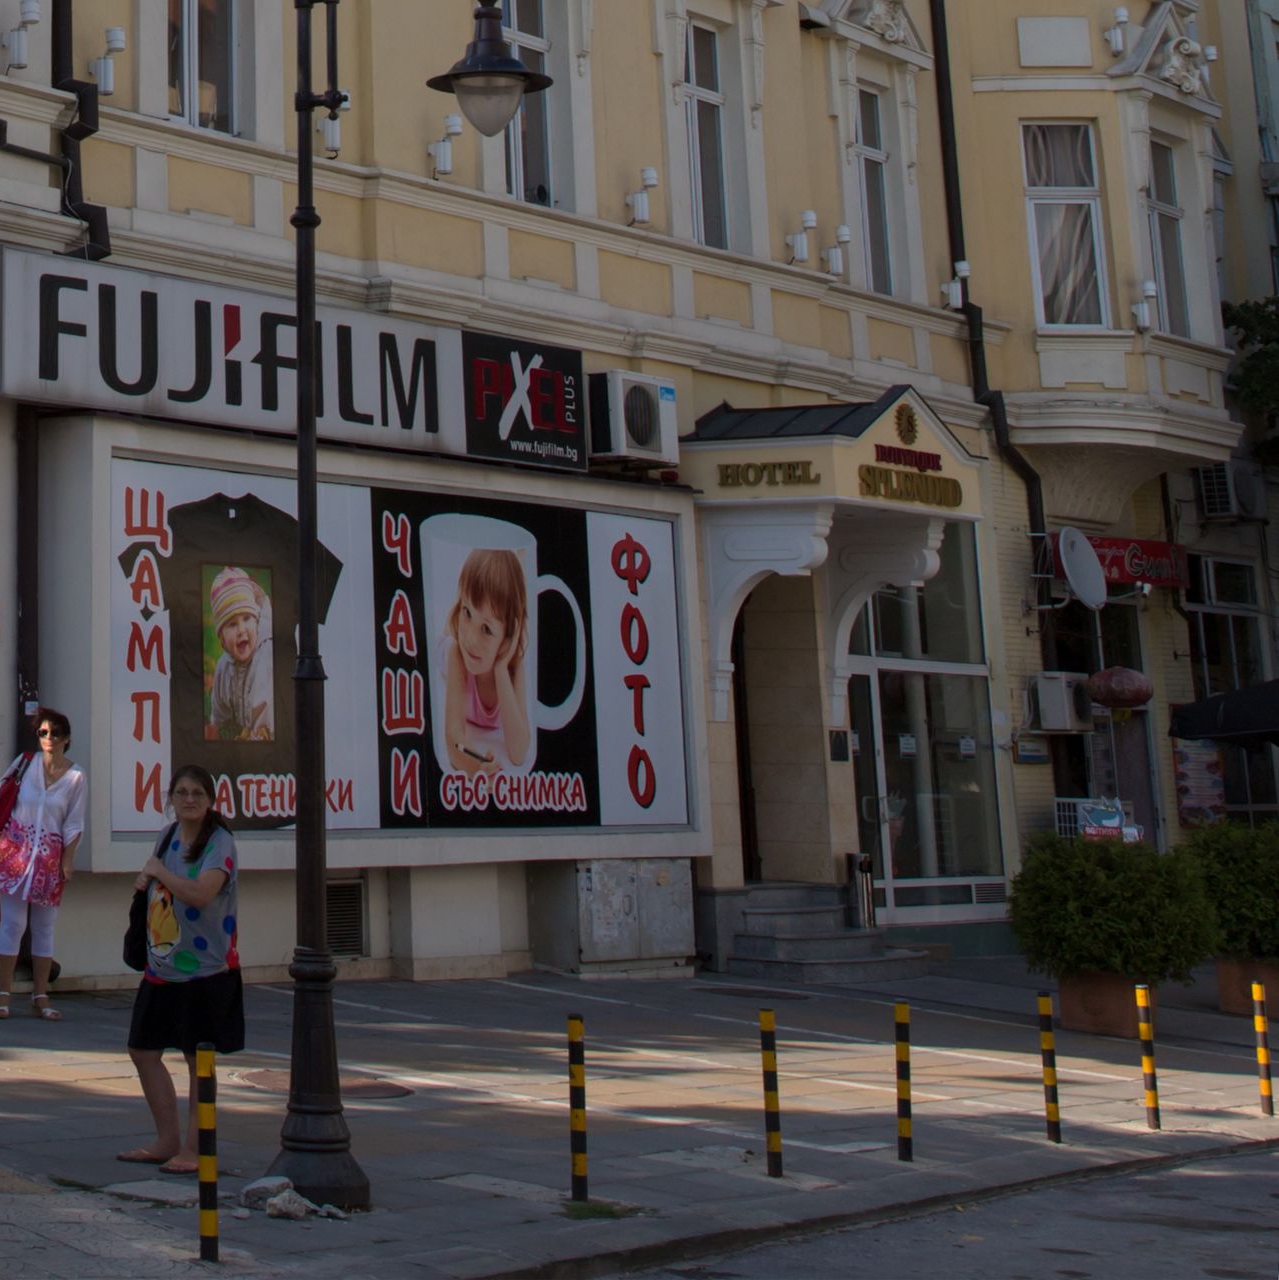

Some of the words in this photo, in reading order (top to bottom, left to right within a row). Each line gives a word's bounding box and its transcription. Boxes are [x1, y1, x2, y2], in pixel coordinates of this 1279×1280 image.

[474, 350, 578, 440] PIXEL
[563, 375, 577, 423] PLUS
[510, 439, 578, 463] www.fujifilm.bg
[717, 460, 821, 488] HOTEL
[858, 464, 962, 508] SPLENDID
[124, 486, 170, 814] ЩАМПИ
[383, 511, 424, 817] ЧАШИ
[611, 533, 655, 809] ФОТО
[238, 774, 354, 817] ТЕНИКИ
[441, 771, 488, 812] СЪС
[493, 770, 587, 812] СНИМКА
